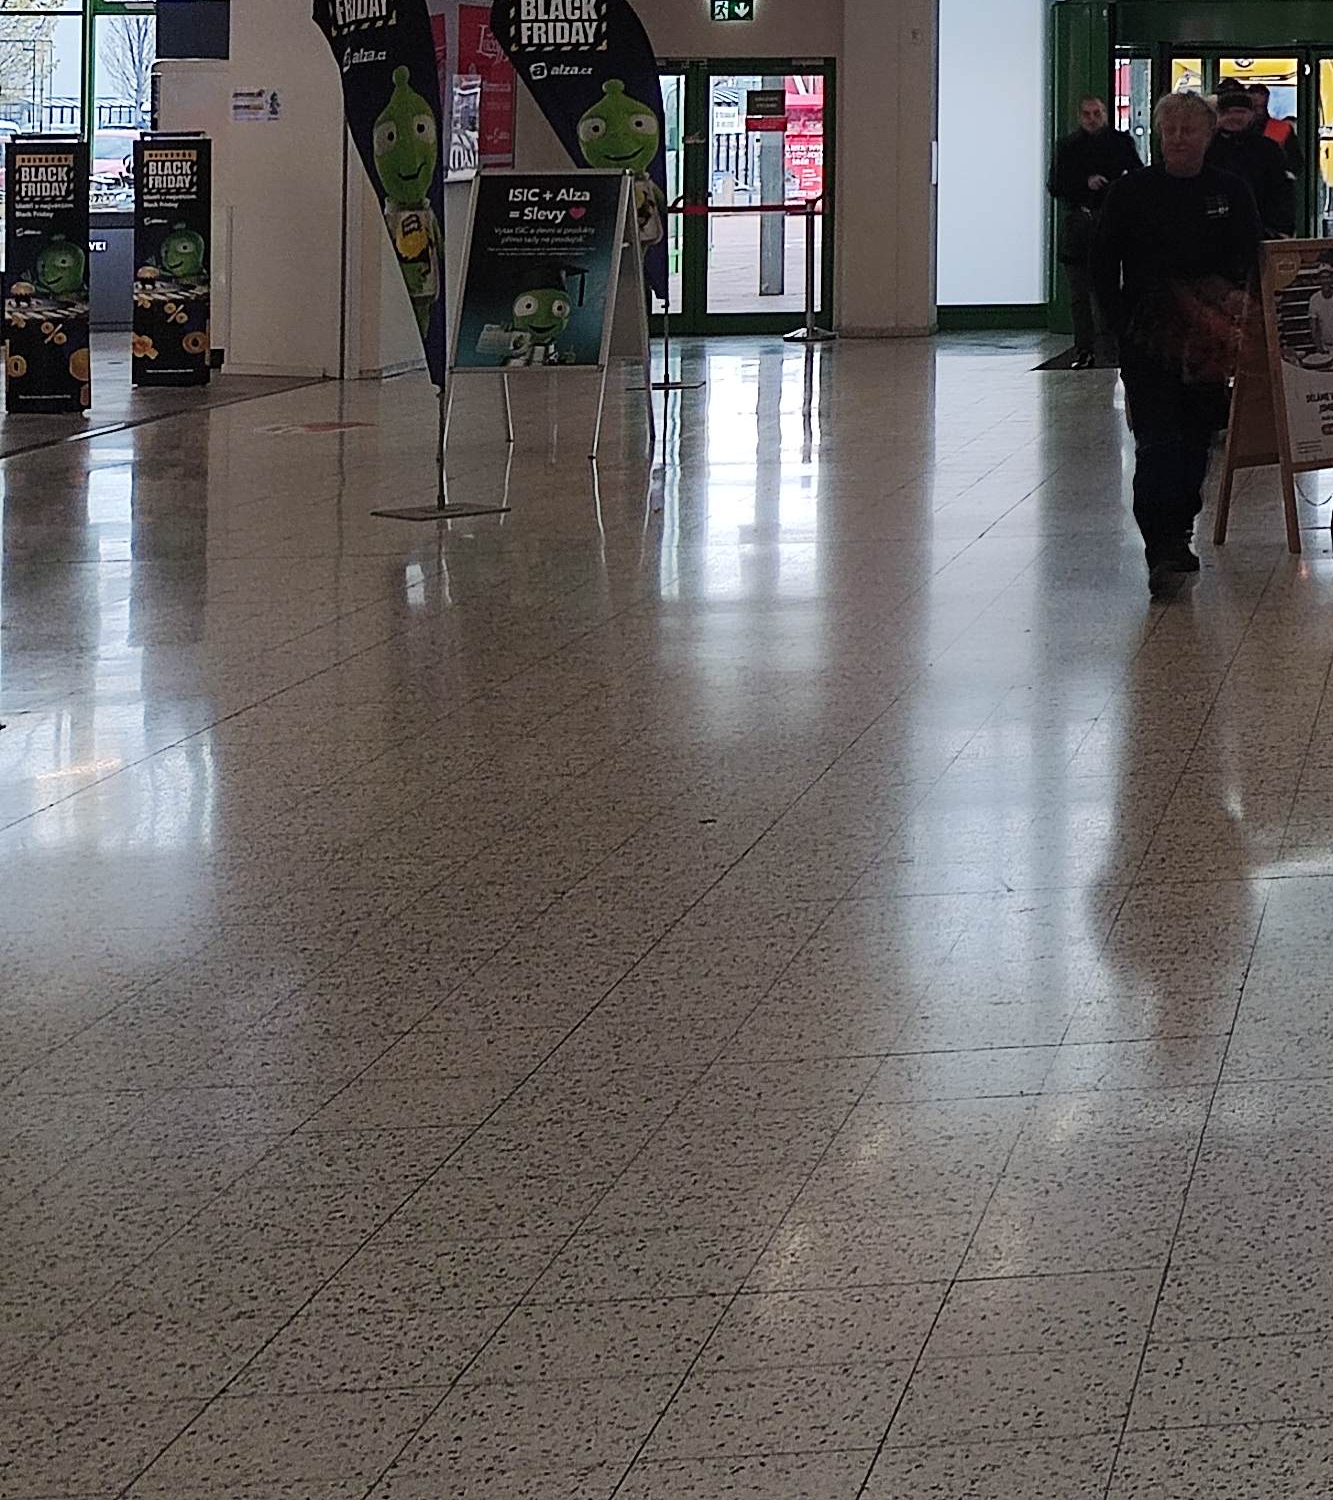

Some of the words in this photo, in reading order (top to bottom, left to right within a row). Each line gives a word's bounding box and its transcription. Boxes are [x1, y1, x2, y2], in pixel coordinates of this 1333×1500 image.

[521, 22, 598, 44] FRIDAY
[21, 167, 69, 182] BLACK
[149, 161, 191, 175] BLACK
[149, 175, 191, 188] FRIDAY
[21, 182, 68, 197] FRIDAY
[508, 188, 540, 201] ISIC
[543, 190, 553, 201] +
[556, 187, 591, 201] Alza
[523, 207, 566, 223] Slevy
